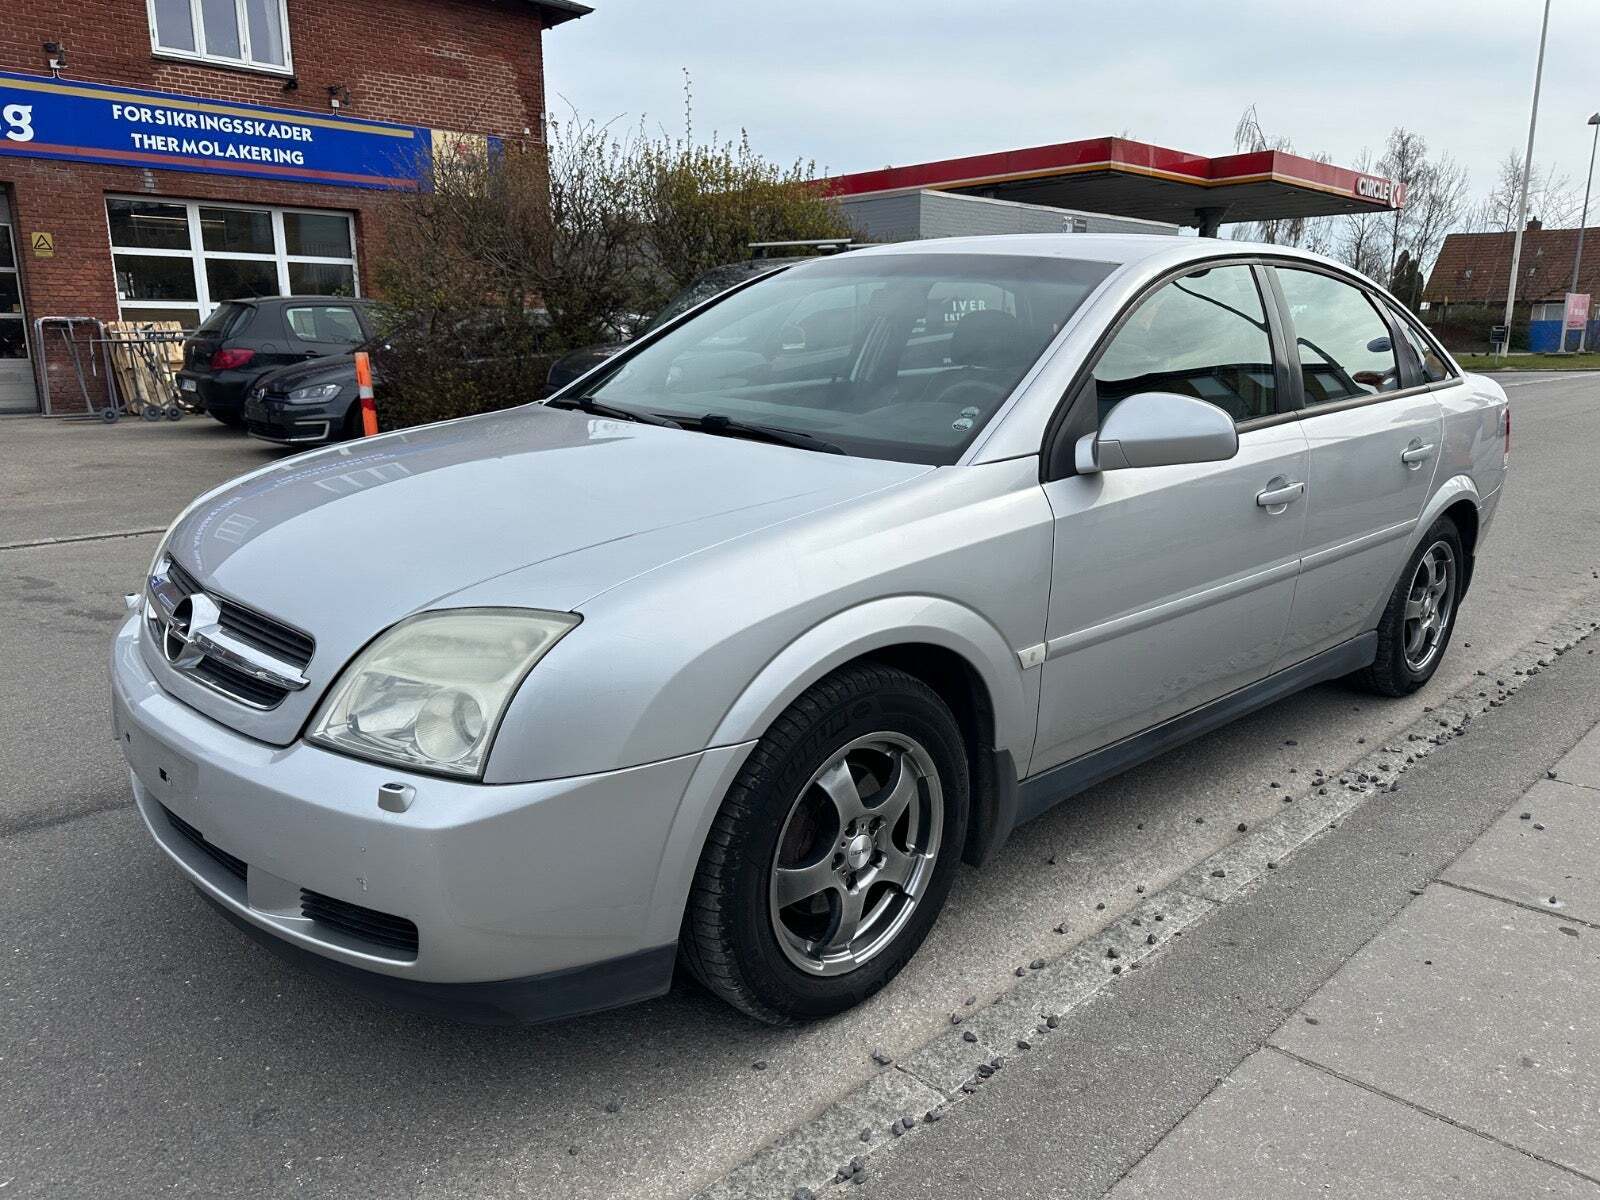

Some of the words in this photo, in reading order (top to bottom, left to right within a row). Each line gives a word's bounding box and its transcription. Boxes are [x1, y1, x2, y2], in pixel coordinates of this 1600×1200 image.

[0, 104, 34, 142] g
[112, 104, 313, 142] FORSIKRINGSSKADER
[130, 132, 305, 165] THERMOLAKERING
[1359, 176, 1390, 200] CIRCLE
